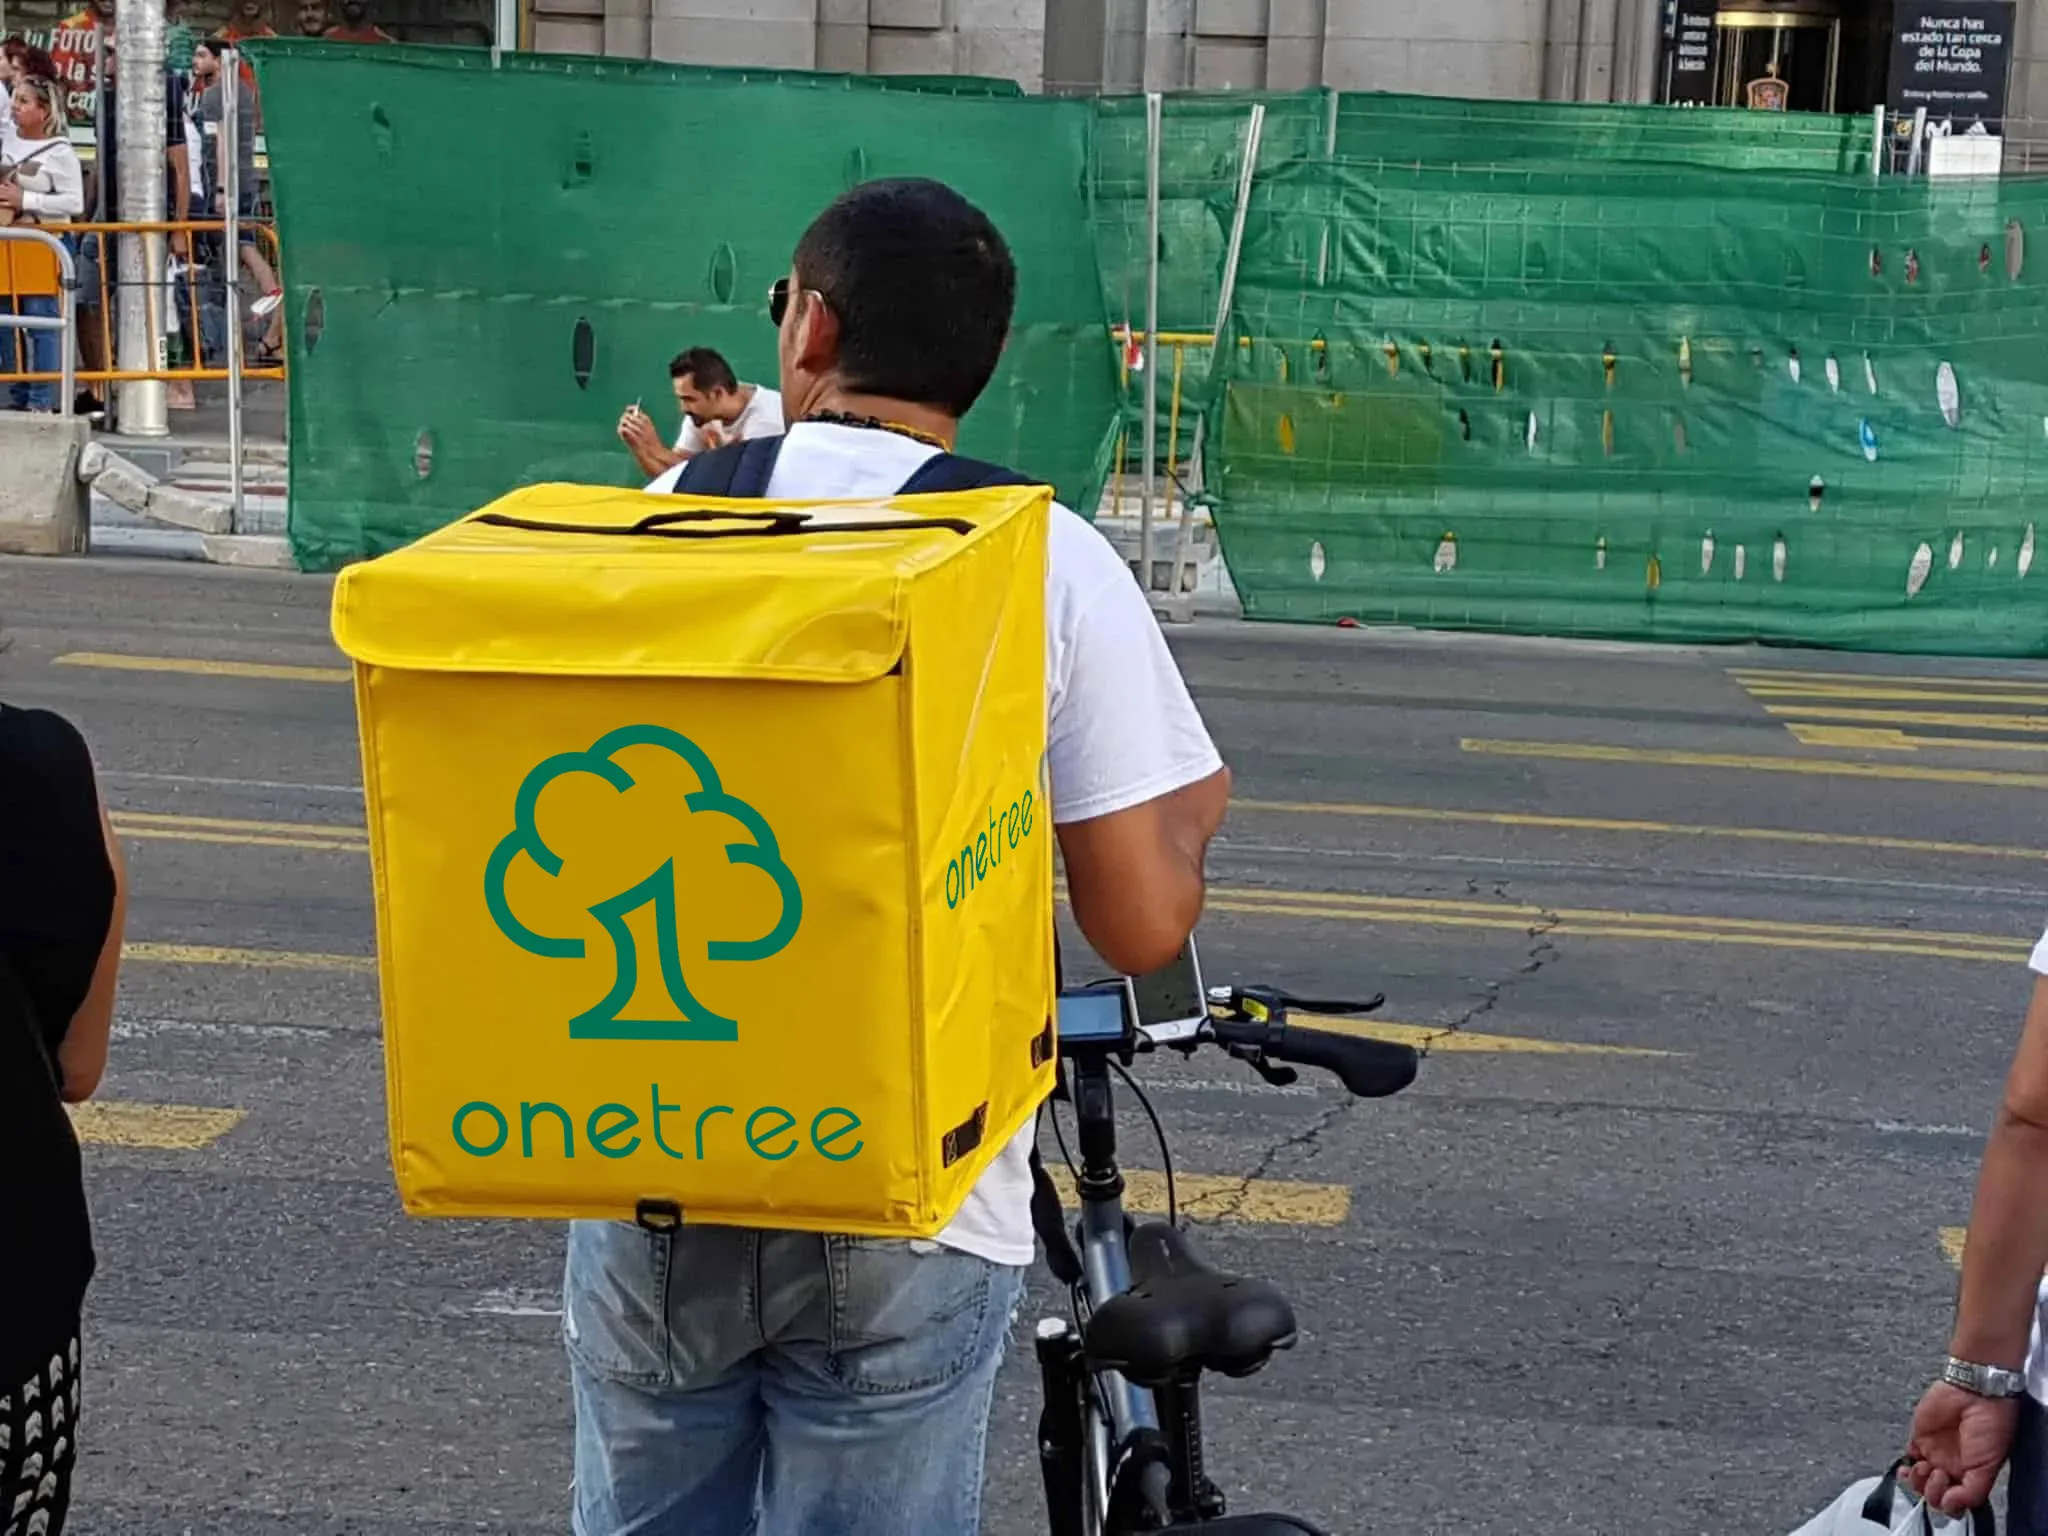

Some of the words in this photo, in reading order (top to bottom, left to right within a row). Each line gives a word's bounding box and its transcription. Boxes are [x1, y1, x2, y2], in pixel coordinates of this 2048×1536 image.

[1920, 16, 1960, 30] Nunca
[48, 28, 96, 53] FOTO
[1901, 32, 1944, 44] estado
[1946, 32, 1967, 44] tan
[1968, 34, 2002, 45] cerca
[1918, 45, 1935, 57] de
[1937, 46, 1948, 57] la
[1950, 45, 1981, 61] Copa
[66, 57, 86, 82] la
[1914, 60, 1934, 73] del
[945, 789, 1033, 910] onetree
[451, 1083, 865, 1162] onetree
